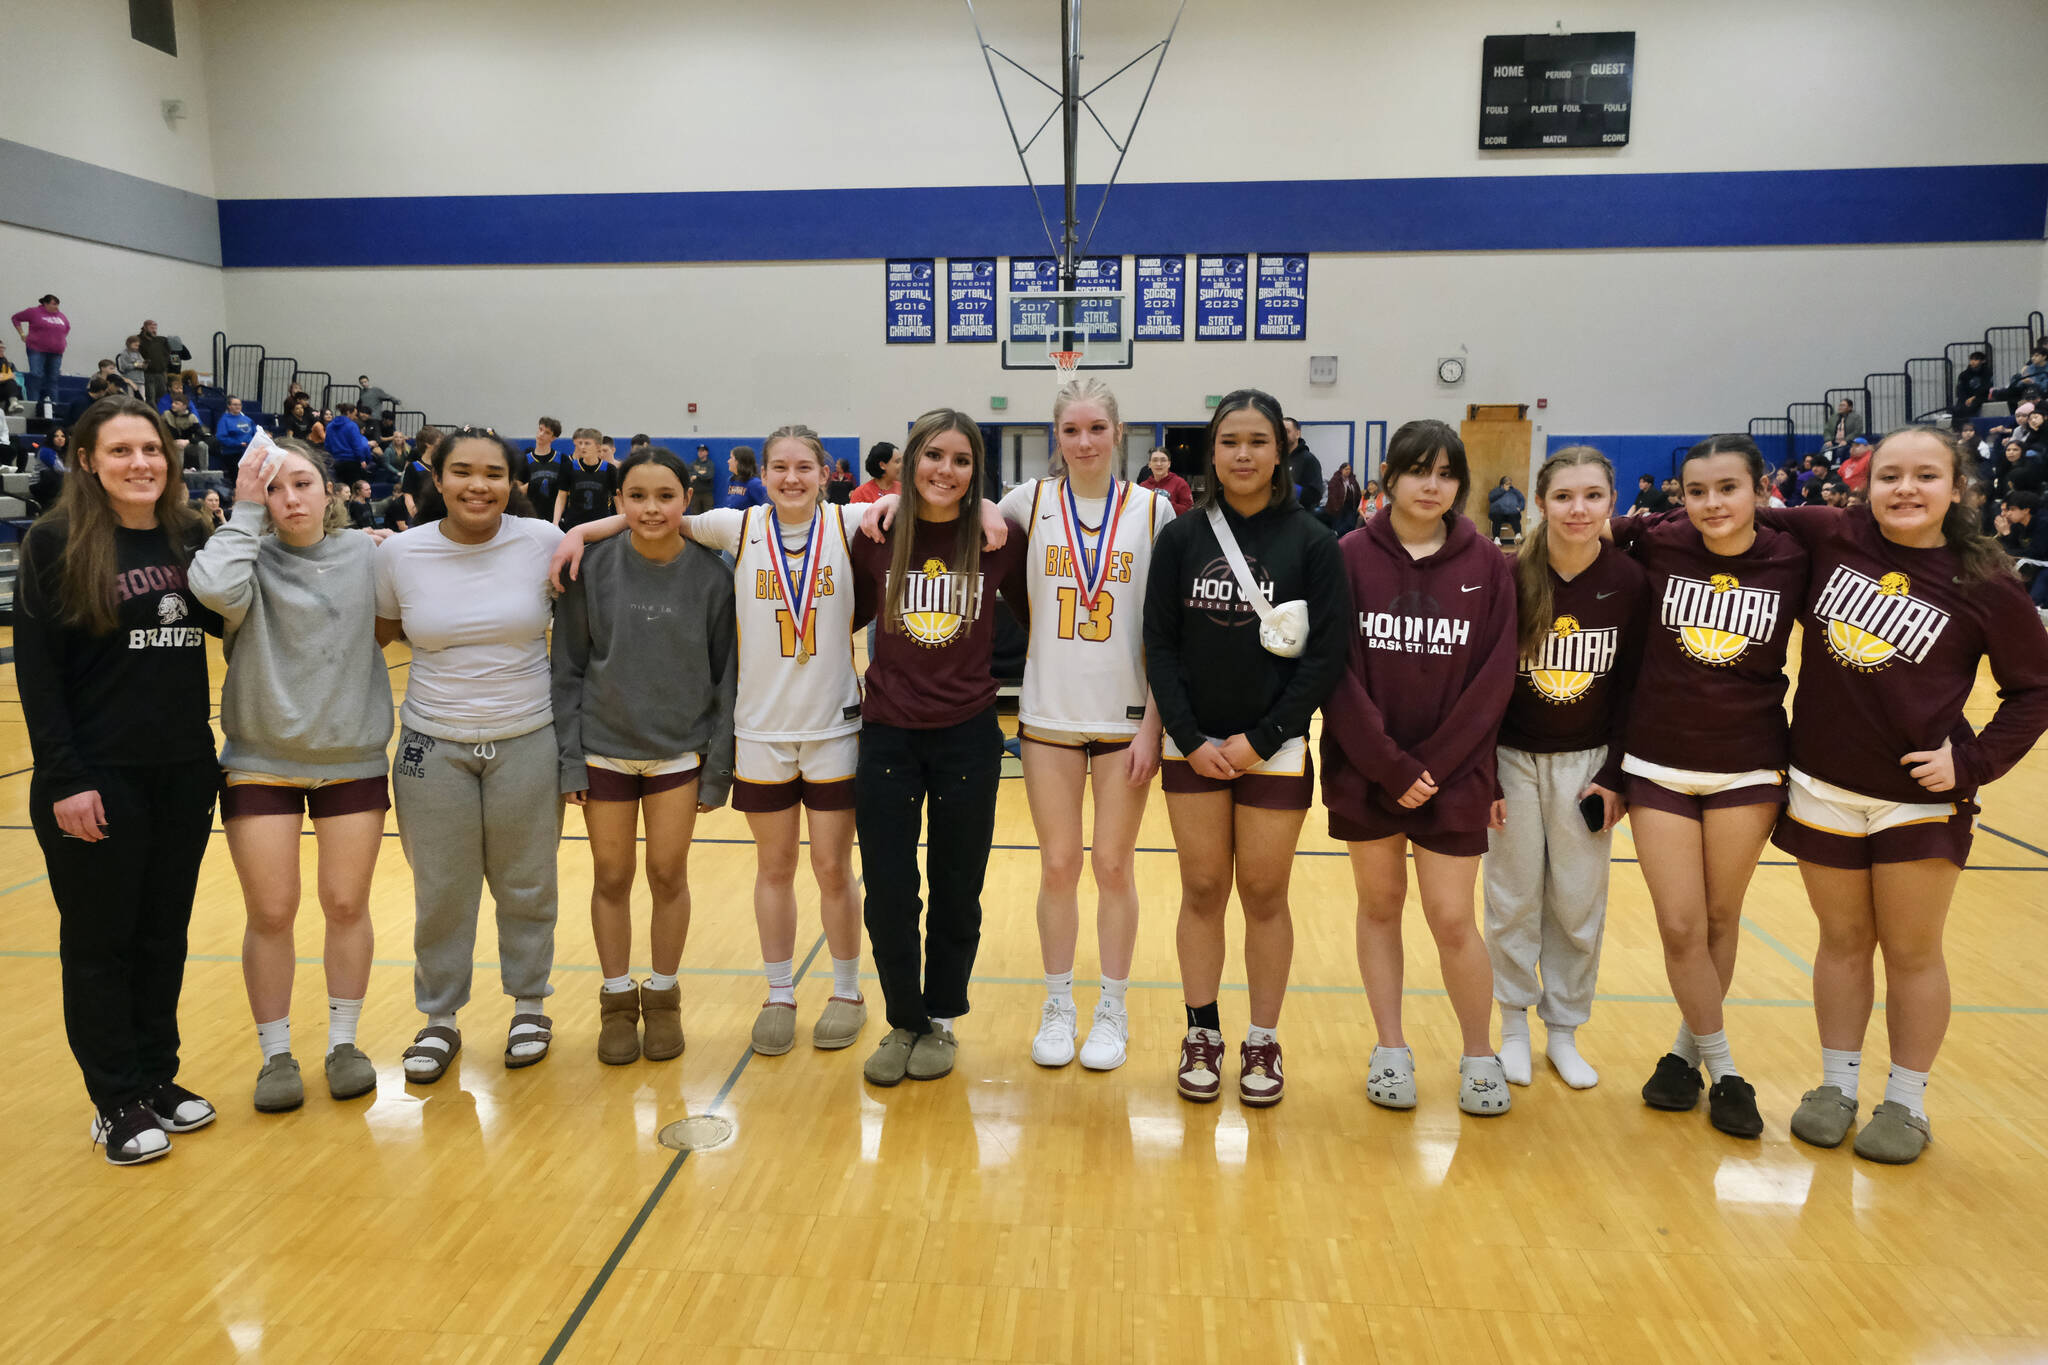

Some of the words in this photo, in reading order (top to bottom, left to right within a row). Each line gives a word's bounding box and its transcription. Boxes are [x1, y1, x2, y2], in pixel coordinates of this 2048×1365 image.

[1493, 65, 1525, 77] HOME
[1590, 62, 1626, 75] GUEST
[1545, 70, 1572, 79] PERIOD
[1485, 105, 1509, 114] FOULS
[1530, 104, 1558, 114] PLAYER
[1562, 104, 1581, 113] FOUL
[1603, 103, 1627, 112] FOULS
[1484, 136, 1508, 145] SCORE
[1542, 135, 1567, 144] MATCH
[1602, 133, 1626, 142] SCORE
[889, 289, 931, 302] SOFTBALL
[951, 289, 993, 301] SOFTBALL
[1143, 288, 1176, 300] SOCCER
[1258, 287, 1305, 300] BASKETBALL
[895, 302, 926, 310] 2016
[956, 302, 988, 310] 2017
[1019, 303, 1050, 311] 2017
[1080, 299, 1113, 307] 2018
[1144, 300, 1175, 308] 2021
[1205, 300, 1239, 308] 2023
[1264, 299, 1299, 307] 2023
[898, 314, 923, 326] STATE
[959, 314, 984, 325] STATE
[1021, 313, 1046, 324] STATE
[1083, 311, 1109, 323] STATE
[1146, 315, 1172, 325] STATE
[1208, 315, 1234, 325] STATE
[1267, 315, 1293, 324] STATE
[889, 325, 931, 337] CHAMPIONS
[951, 325, 993, 336] CHAMPIONS
[1137, 325, 1181, 335] CHAMPIONS
[1199, 325, 1231, 335] RUNNER
[1232, 325, 1243, 335] UP
[1260, 324, 1289, 335] RUNNER
[1290, 324, 1301, 335] UP
[1045, 544, 1134, 583] BRES
[112, 565, 188, 606] HOON
[755, 565, 835, 600] BRES
[1192, 577, 1274, 602] HOOH
[885, 572, 985, 620] OONAH
[1189, 600, 1256, 611] BASKETB
[1661, 577, 1781, 643] HOONAH
[1056, 586, 1115, 643] 13
[1813, 566, 1950, 665] HOONAH
[775, 608, 817, 658] 11
[1359, 611, 1470, 646] HOONAH
[128, 627, 204, 650] BRAVES
[899, 625, 965, 650] BASKETBALL
[1519, 628, 1618, 673] OONAH
[1821, 629, 1893, 673] BASKETBALL
[398, 763, 425, 779] SUNS
